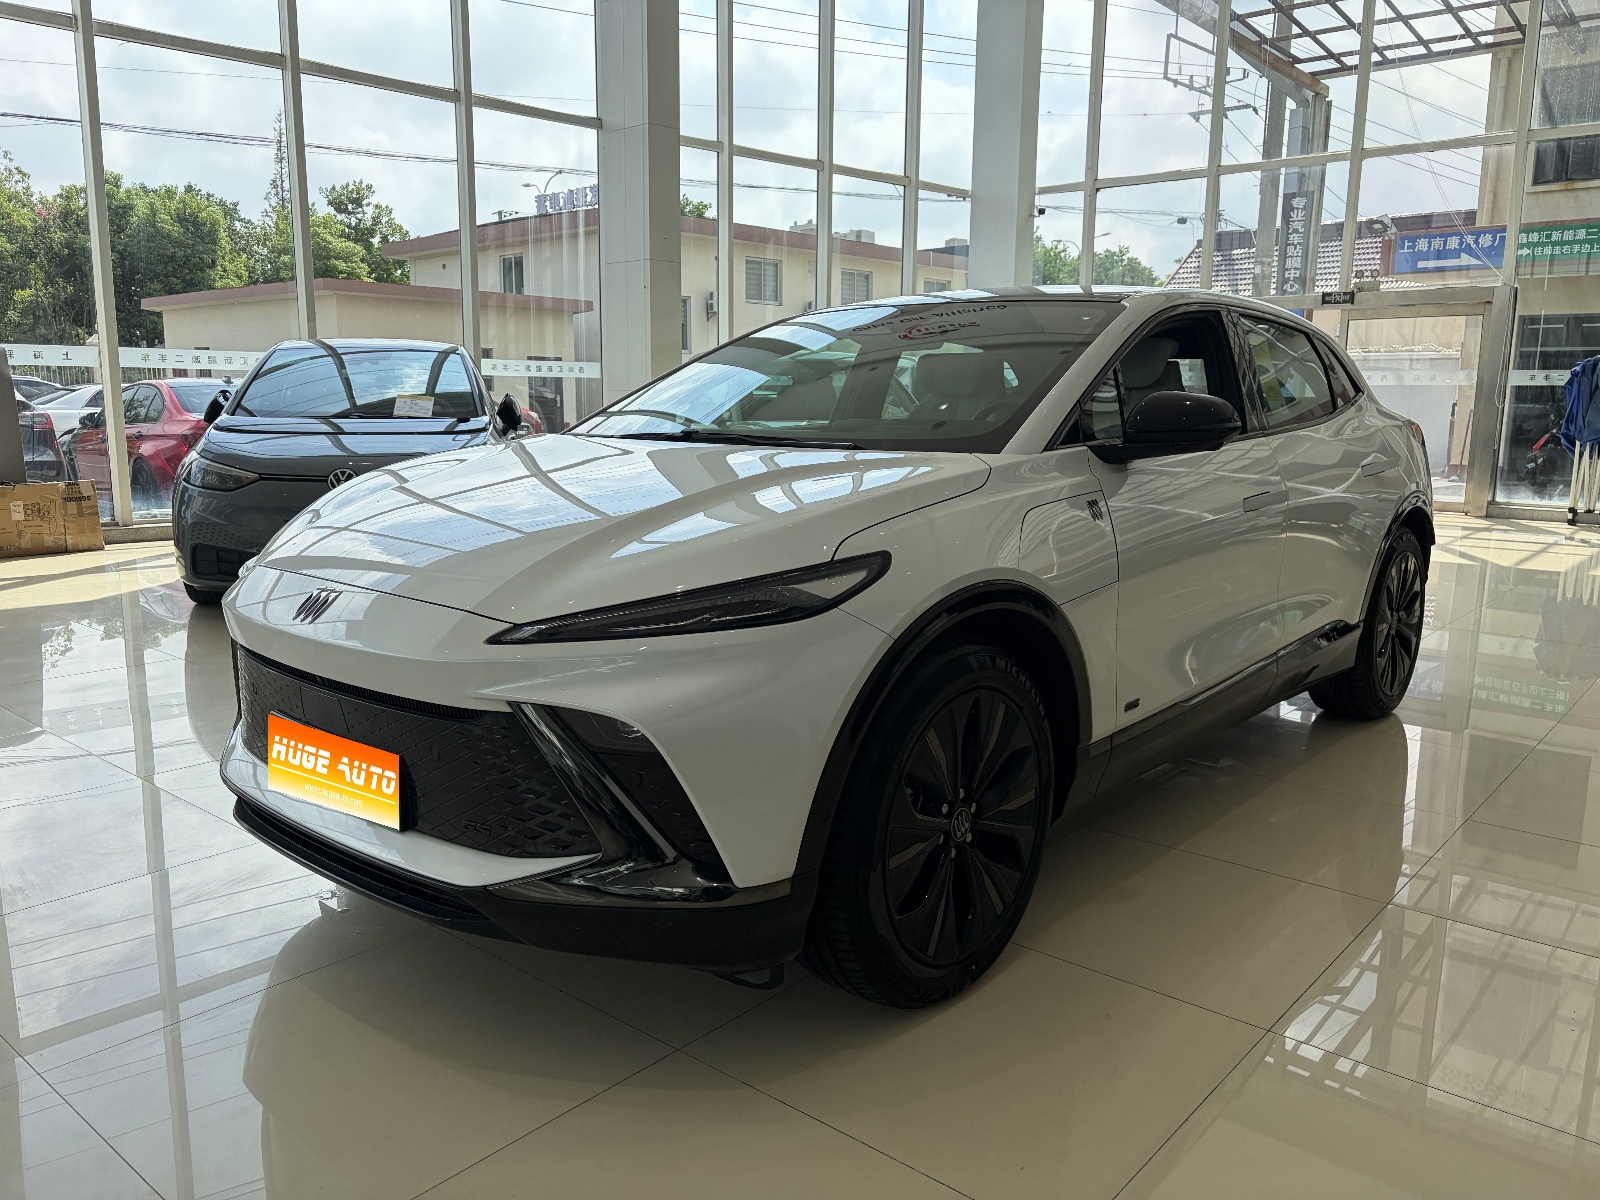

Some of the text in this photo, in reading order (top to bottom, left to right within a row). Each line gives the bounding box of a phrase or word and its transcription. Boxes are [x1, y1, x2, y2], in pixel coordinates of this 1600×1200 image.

[1283, 197, 1307, 292] 专业汽车贴膜中心
[1399, 231, 1507, 253] 上海南康汽修厂
[1518, 228, 1600, 243] 鑫峰汇新能源二
